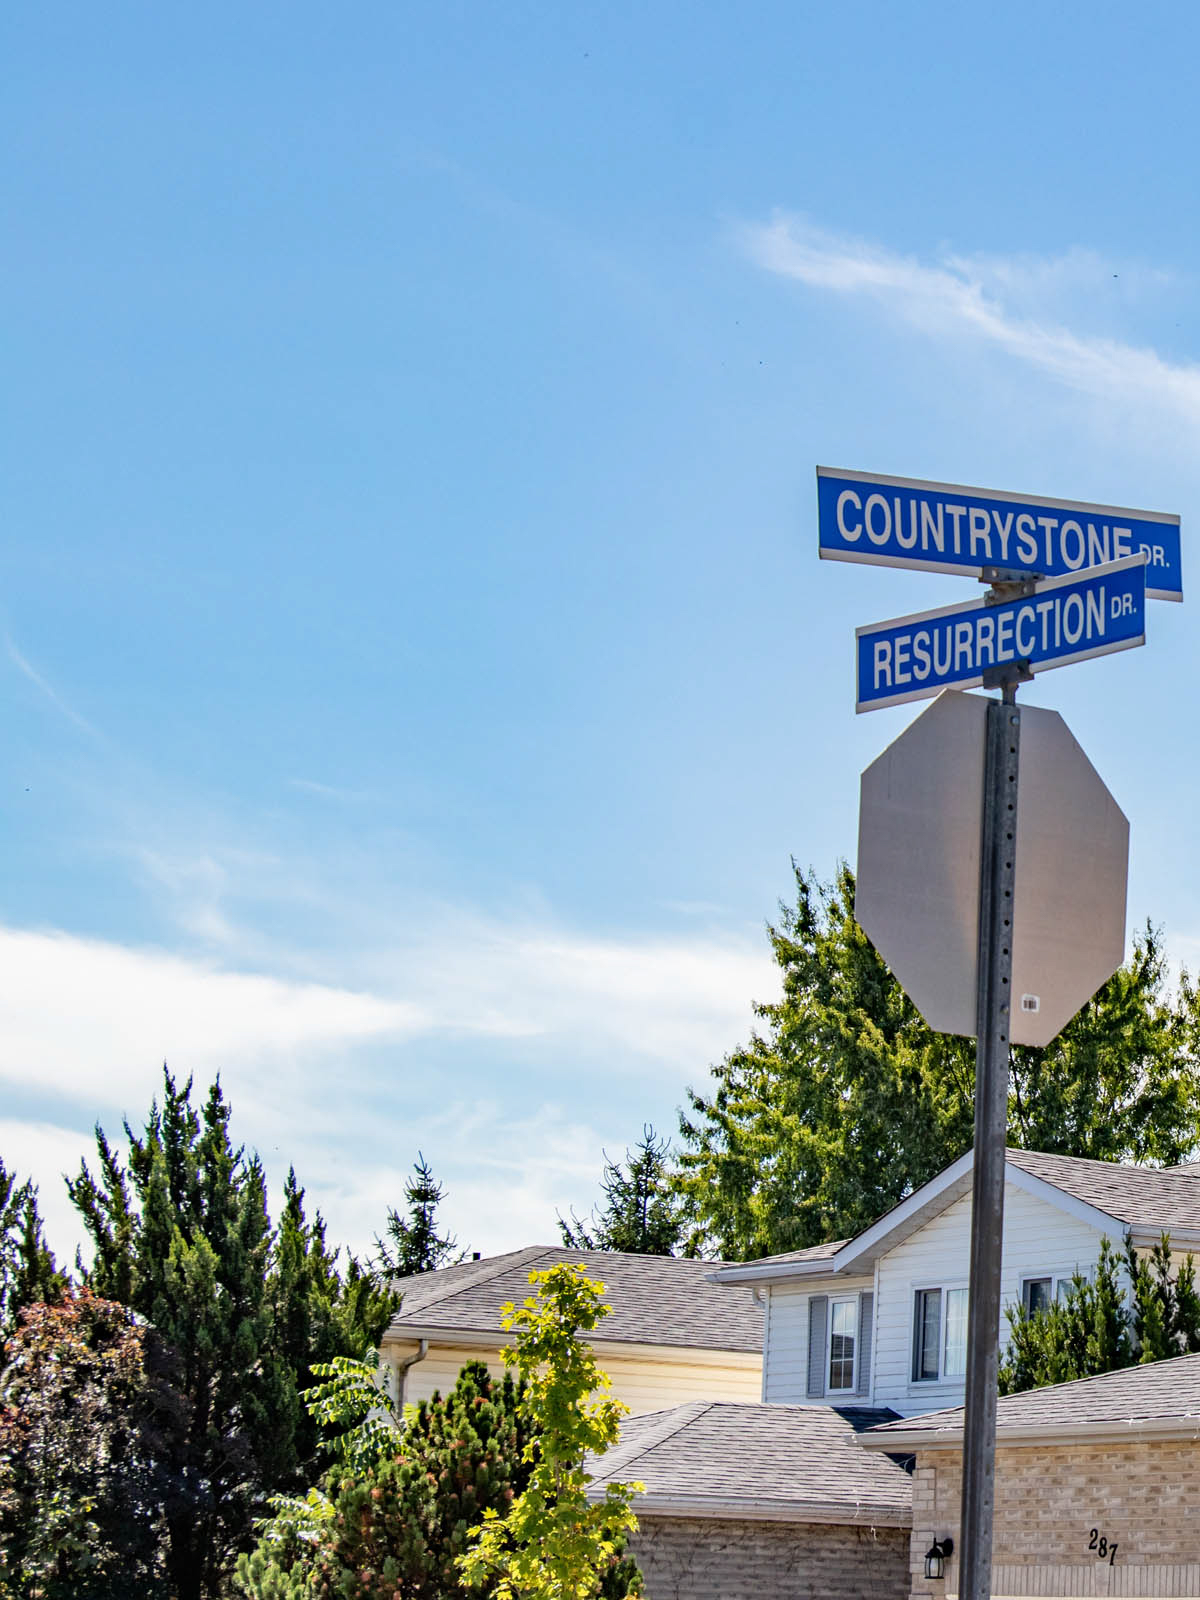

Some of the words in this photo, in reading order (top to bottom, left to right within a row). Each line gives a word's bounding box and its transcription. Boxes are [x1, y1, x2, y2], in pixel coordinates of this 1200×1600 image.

[836, 490, 1132, 569] COUNTRYSTONE
[1139, 543, 1170, 568] DR.
[873, 587, 1105, 689] RESURRECTION
[1111, 593, 1137, 619] DR.
[1089, 1528, 1118, 1566] 287
